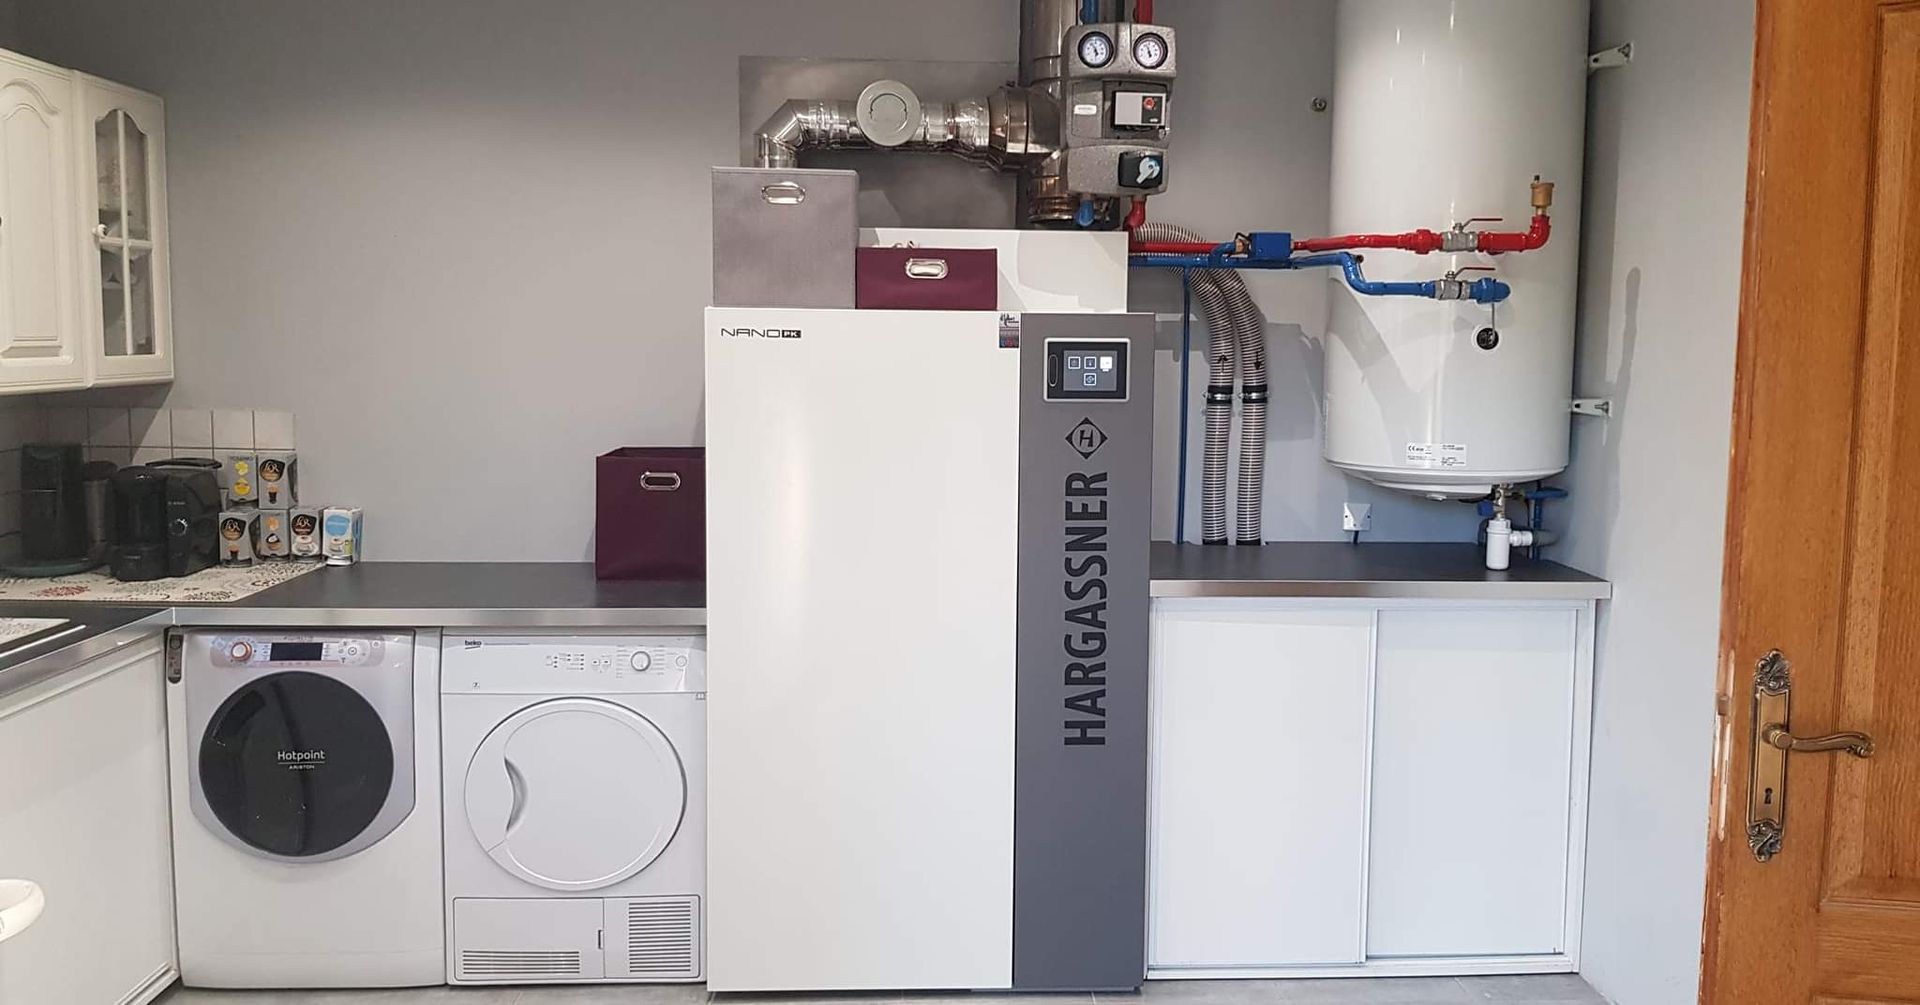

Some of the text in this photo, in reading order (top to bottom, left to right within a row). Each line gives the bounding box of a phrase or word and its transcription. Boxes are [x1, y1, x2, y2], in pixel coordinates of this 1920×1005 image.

[721, 328, 780, 338] NANO
[1064, 472, 1108, 746] HARGASSNER
[277, 750, 326, 762] Hotpoint
